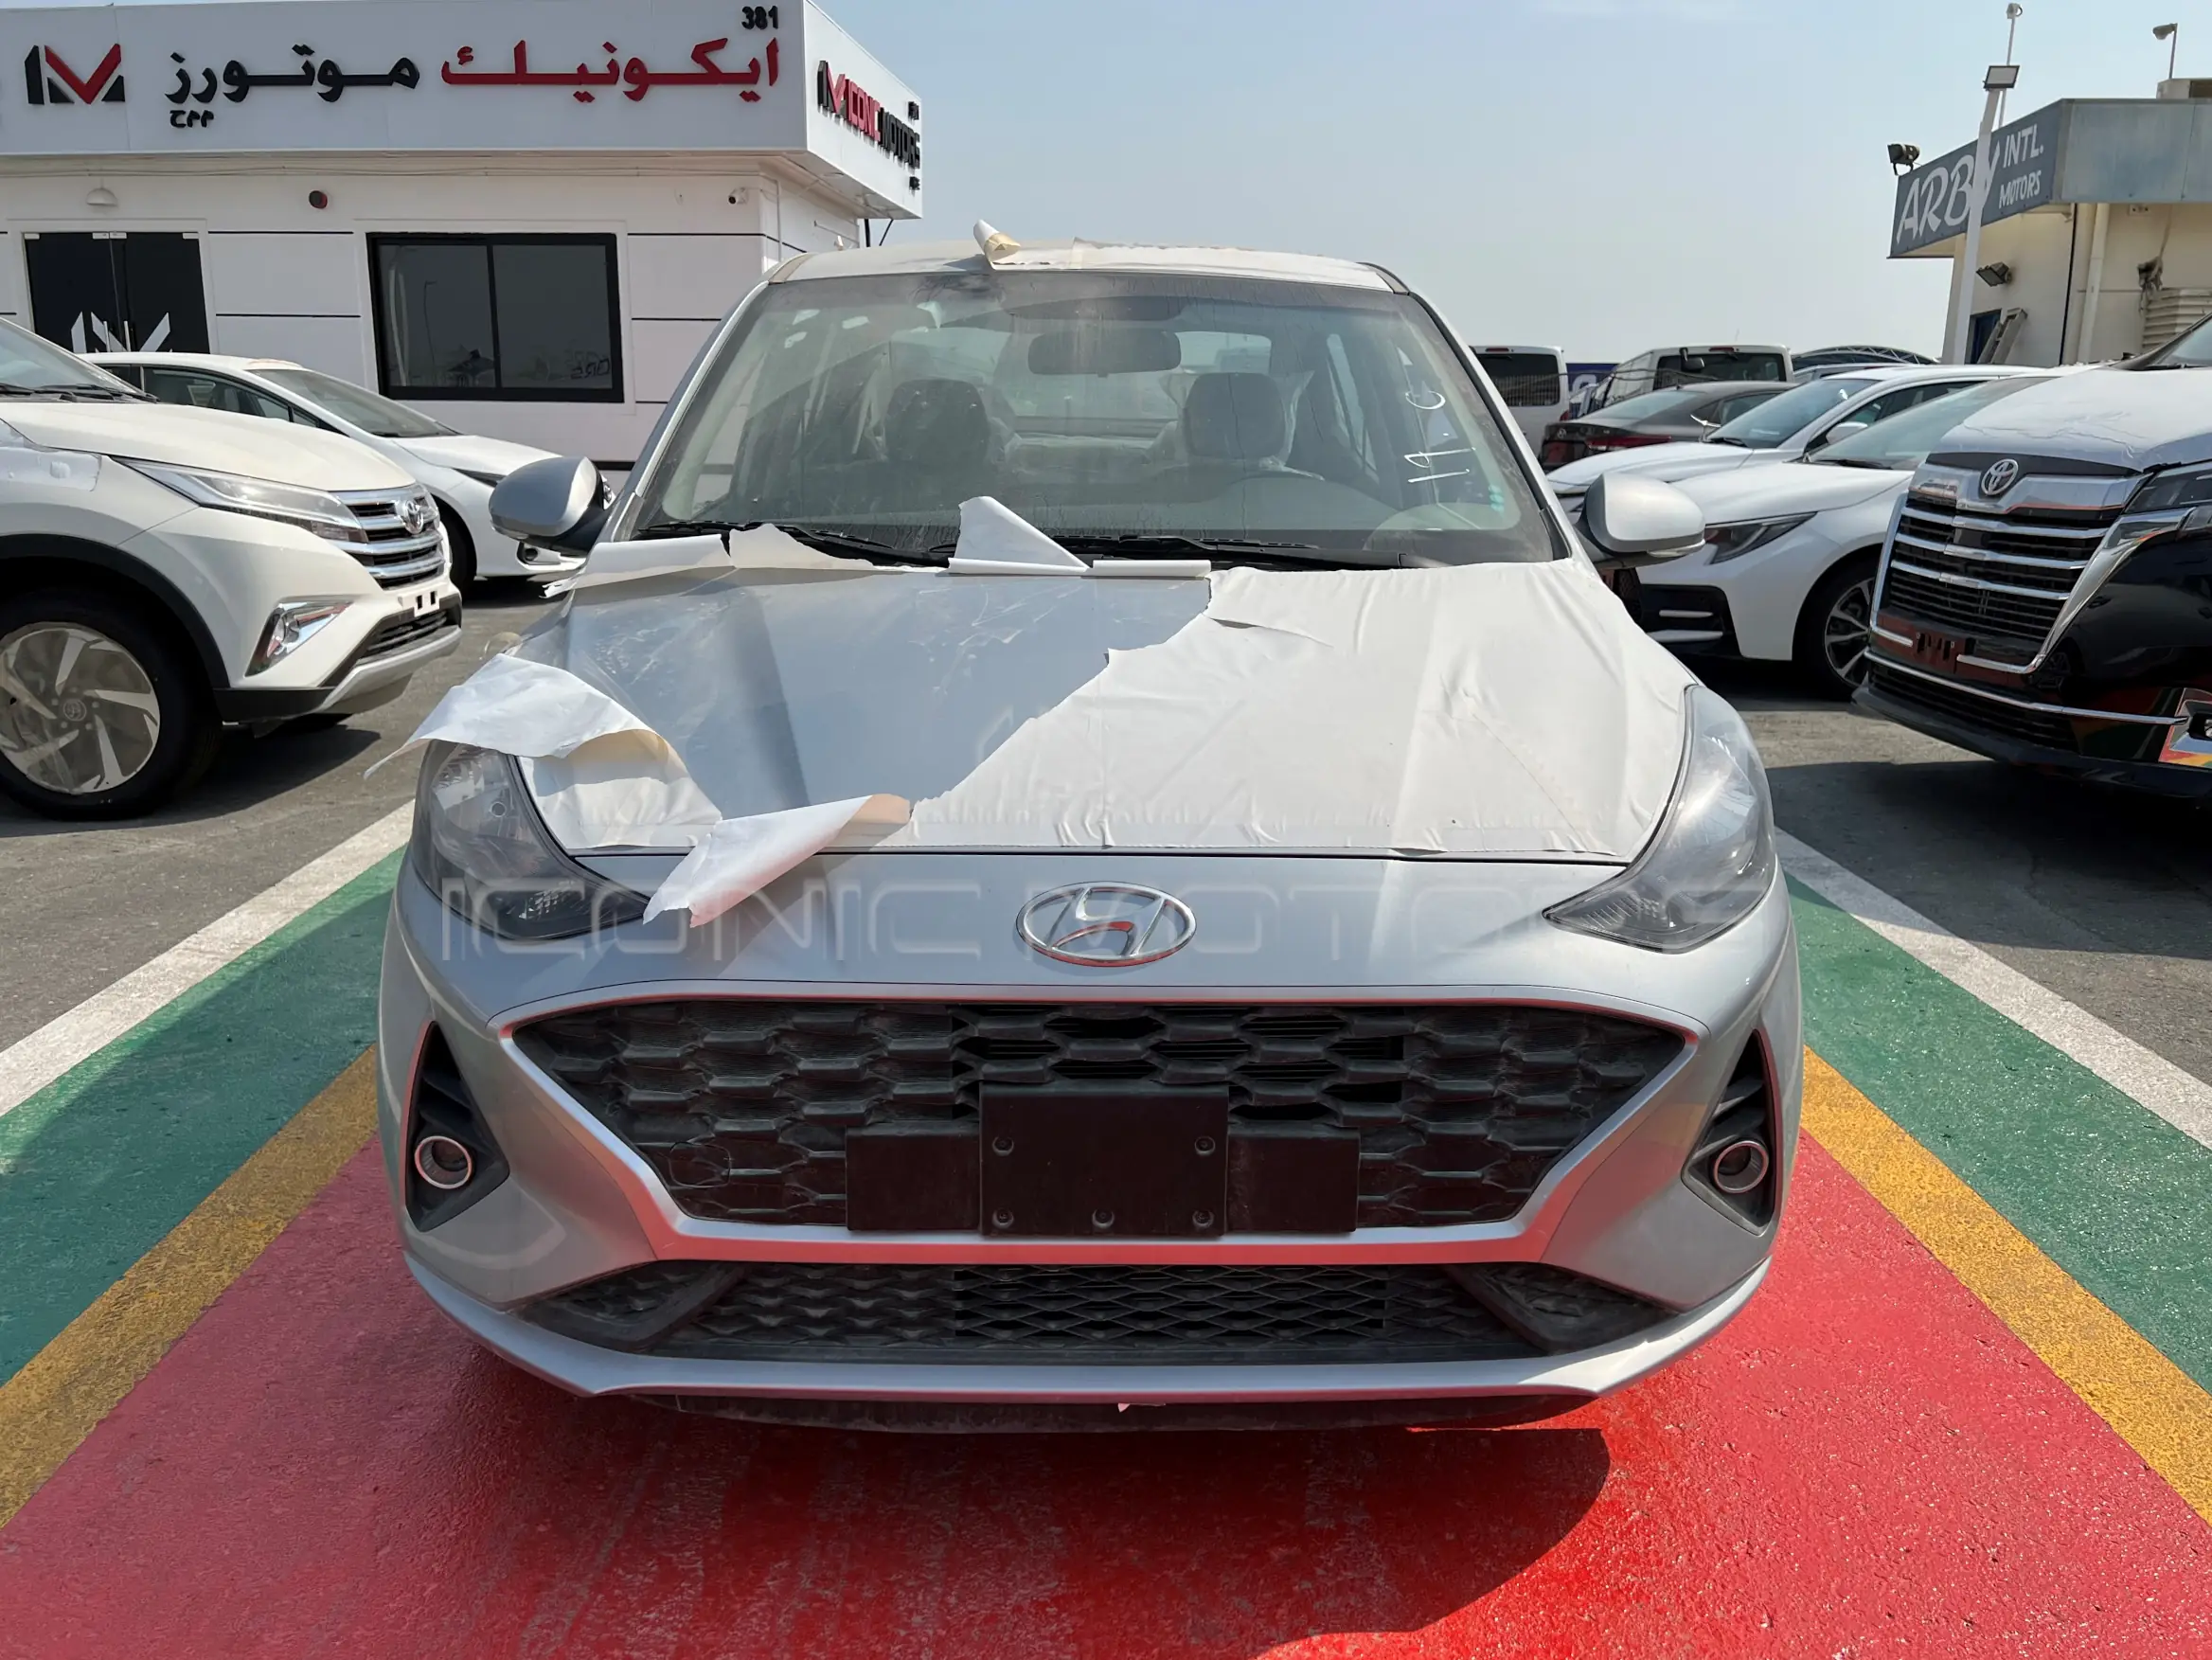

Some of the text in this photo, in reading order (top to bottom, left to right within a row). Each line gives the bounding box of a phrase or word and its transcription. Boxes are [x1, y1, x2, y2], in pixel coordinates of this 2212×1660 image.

[740, 5, 779, 30] 381
[165, 44, 420, 103] موتورز
[2003, 123, 2044, 169] INTL.
[1998, 170, 2043, 209] MOTORS
